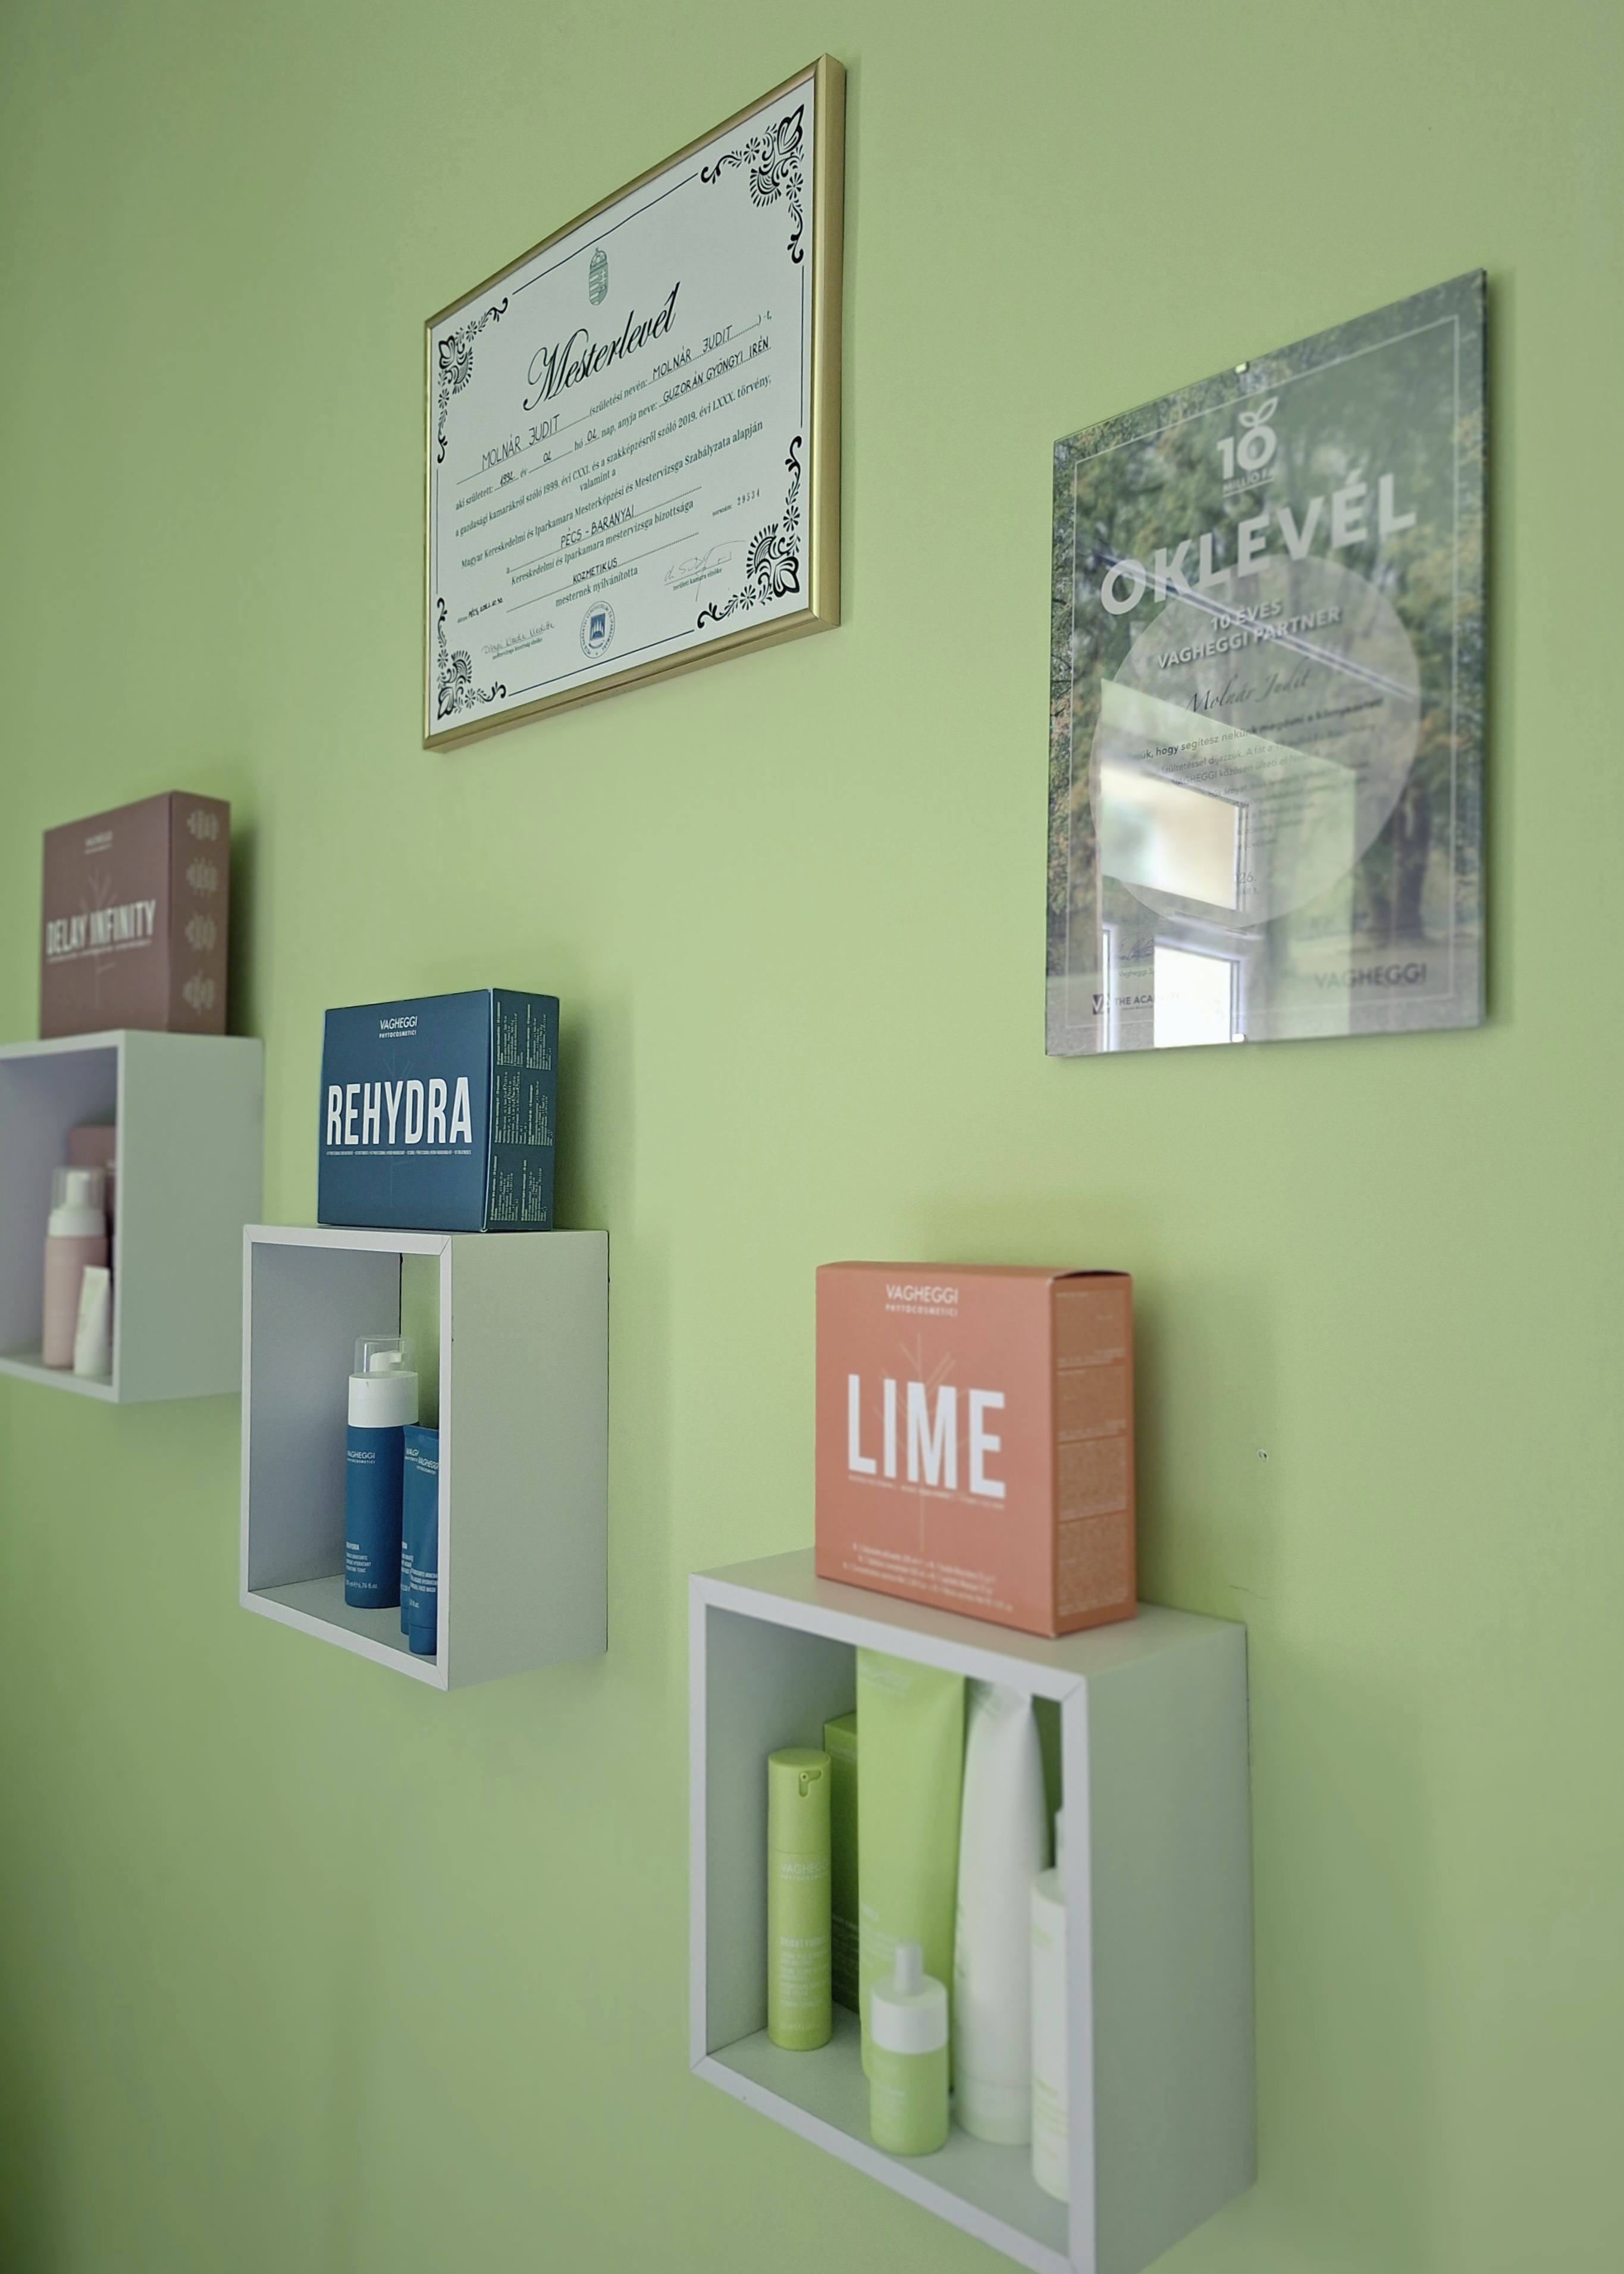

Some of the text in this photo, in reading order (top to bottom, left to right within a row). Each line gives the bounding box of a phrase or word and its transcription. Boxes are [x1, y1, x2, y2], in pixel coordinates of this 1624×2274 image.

[523, 281, 681, 411] Mesterlevél
[456, 498, 465, 510] aki
[466, 486, 494, 505] született:
[520, 468, 528, 478] év
[575, 438, 584, 451] hó
[601, 424, 617, 438] nap,
[617, 412, 637, 430] anyja
[638, 402, 657, 418] neve:
[663, 370, 704, 403] GUZORÁN
[706, 350, 744, 381] GYÖNGYI
[749, 335, 769, 359] IRÉN
[482, 434, 521, 471] MOLNÁR
[529, 414, 560, 445] JUDIT
[590, 390, 623, 416] (születési
[624, 379, 647, 399] nevén:
[653, 346, 692, 380] MOLNÁR
[703, 325, 733, 353] JUDIT
[460, 513, 488, 537] gazdasági
[489, 495, 525, 521] kamarákról
[526, 487, 543, 504] szóló
[544, 480, 560, 495] 1999.
[561, 472, 571, 486] évi
[572, 465, 591, 481] CXXI.
[592, 460, 600, 472] és
[601, 459, 605, 467] a
[606, 430, 656, 464] szakképzésről
[657, 420, 676, 439] szóló
[678, 411, 698, 429] 2019.
[699, 402, 711, 418] évi
[713, 391, 735, 412] LXXX.
[579, 468, 616, 492] valamint a
[462, 421, 763, 569] Magyar Kereskedelmi és Iparkamara Mesterképzési és Mestervizsga Szabályzata alapján
[511, 500, 694, 585] Kereskedelmi és Iparkamara mestervizsga bizottsága
[560, 527, 583, 548] PÉCS
[591, 504, 634, 536] BARANYAI
[1101, 468, 1416, 616] OKLEVÉL
[556, 567, 638, 607] mesternek nyilvánította
[572, 557, 618, 585] KOZMETIKUS
[1157, 607, 1341, 669] VAGHEGGI PARTNER
[1156, 745, 1179, 756] hogy
[1181, 736, 1219, 751] segítesz
[1315, 962, 1427, 989] VAGHEGGI
[379, 1029, 416, 1039] PHYTOCOSMETICI
[380, 1016, 418, 1030] VAGHEGGI
[326, 1076, 473, 1146] REHYDRA
[886, 1284, 958, 1304] VAGHEGGI
[848, 1373, 1006, 1499] LIME
[780, 1859, 828, 1874] VAGHEGG
